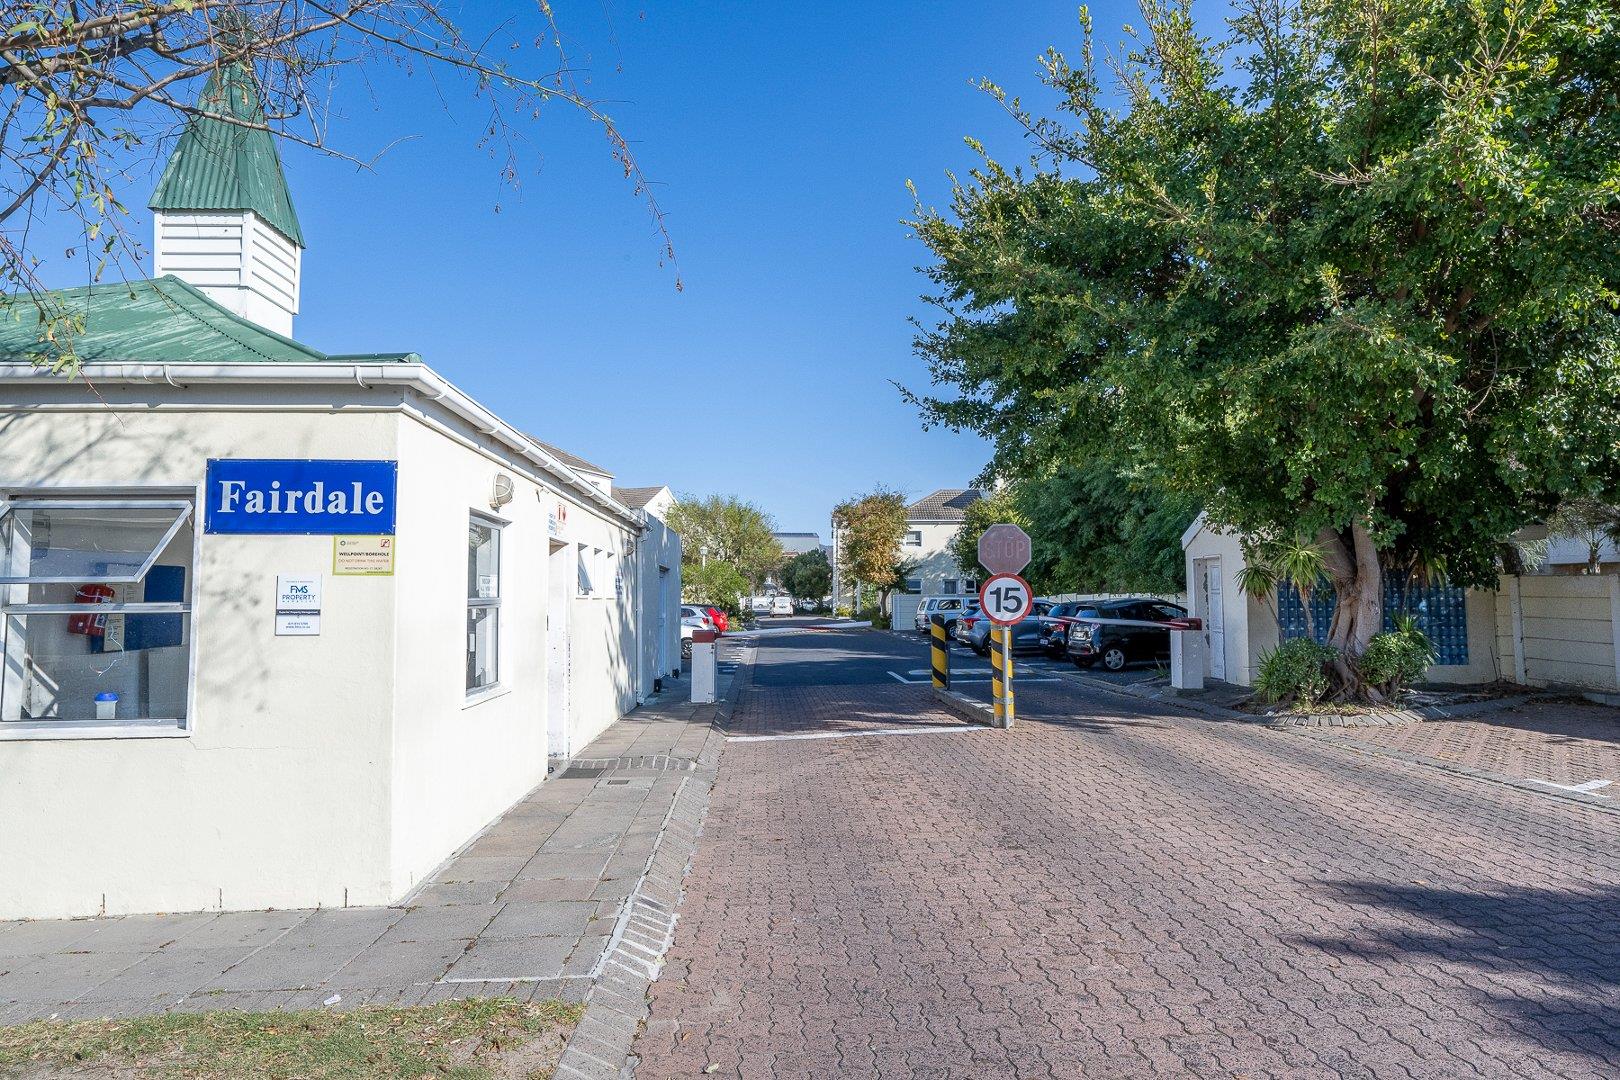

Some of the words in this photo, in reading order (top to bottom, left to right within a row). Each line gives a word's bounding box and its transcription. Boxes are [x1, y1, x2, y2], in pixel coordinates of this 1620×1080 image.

[217, 480, 384, 515] Fairdale
[985, 540, 1025, 558] STOP
[290, 585, 308, 594] FMS
[989, 586, 1023, 613] 15
